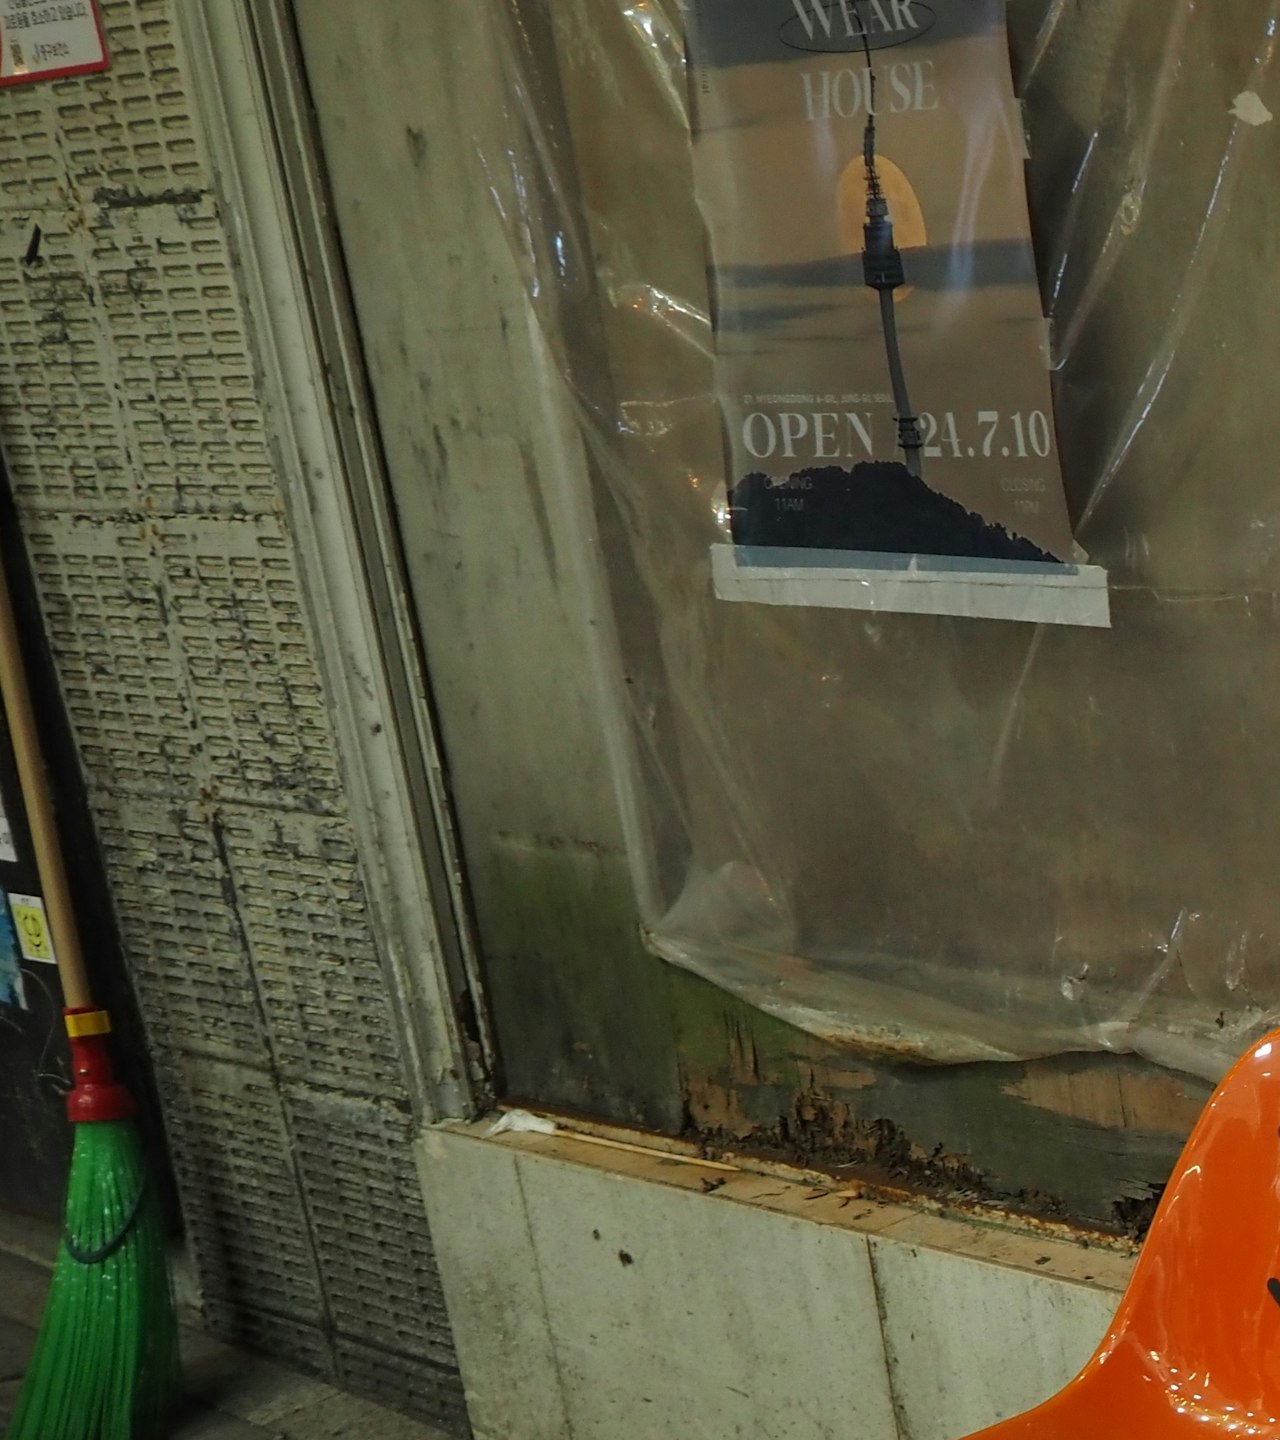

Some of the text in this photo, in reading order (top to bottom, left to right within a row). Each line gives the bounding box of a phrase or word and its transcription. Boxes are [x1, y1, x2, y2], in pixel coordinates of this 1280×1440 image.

[801, 61, 939, 121] HOUSE
[742, 410, 1050, 458] OPEN 24.7.10
